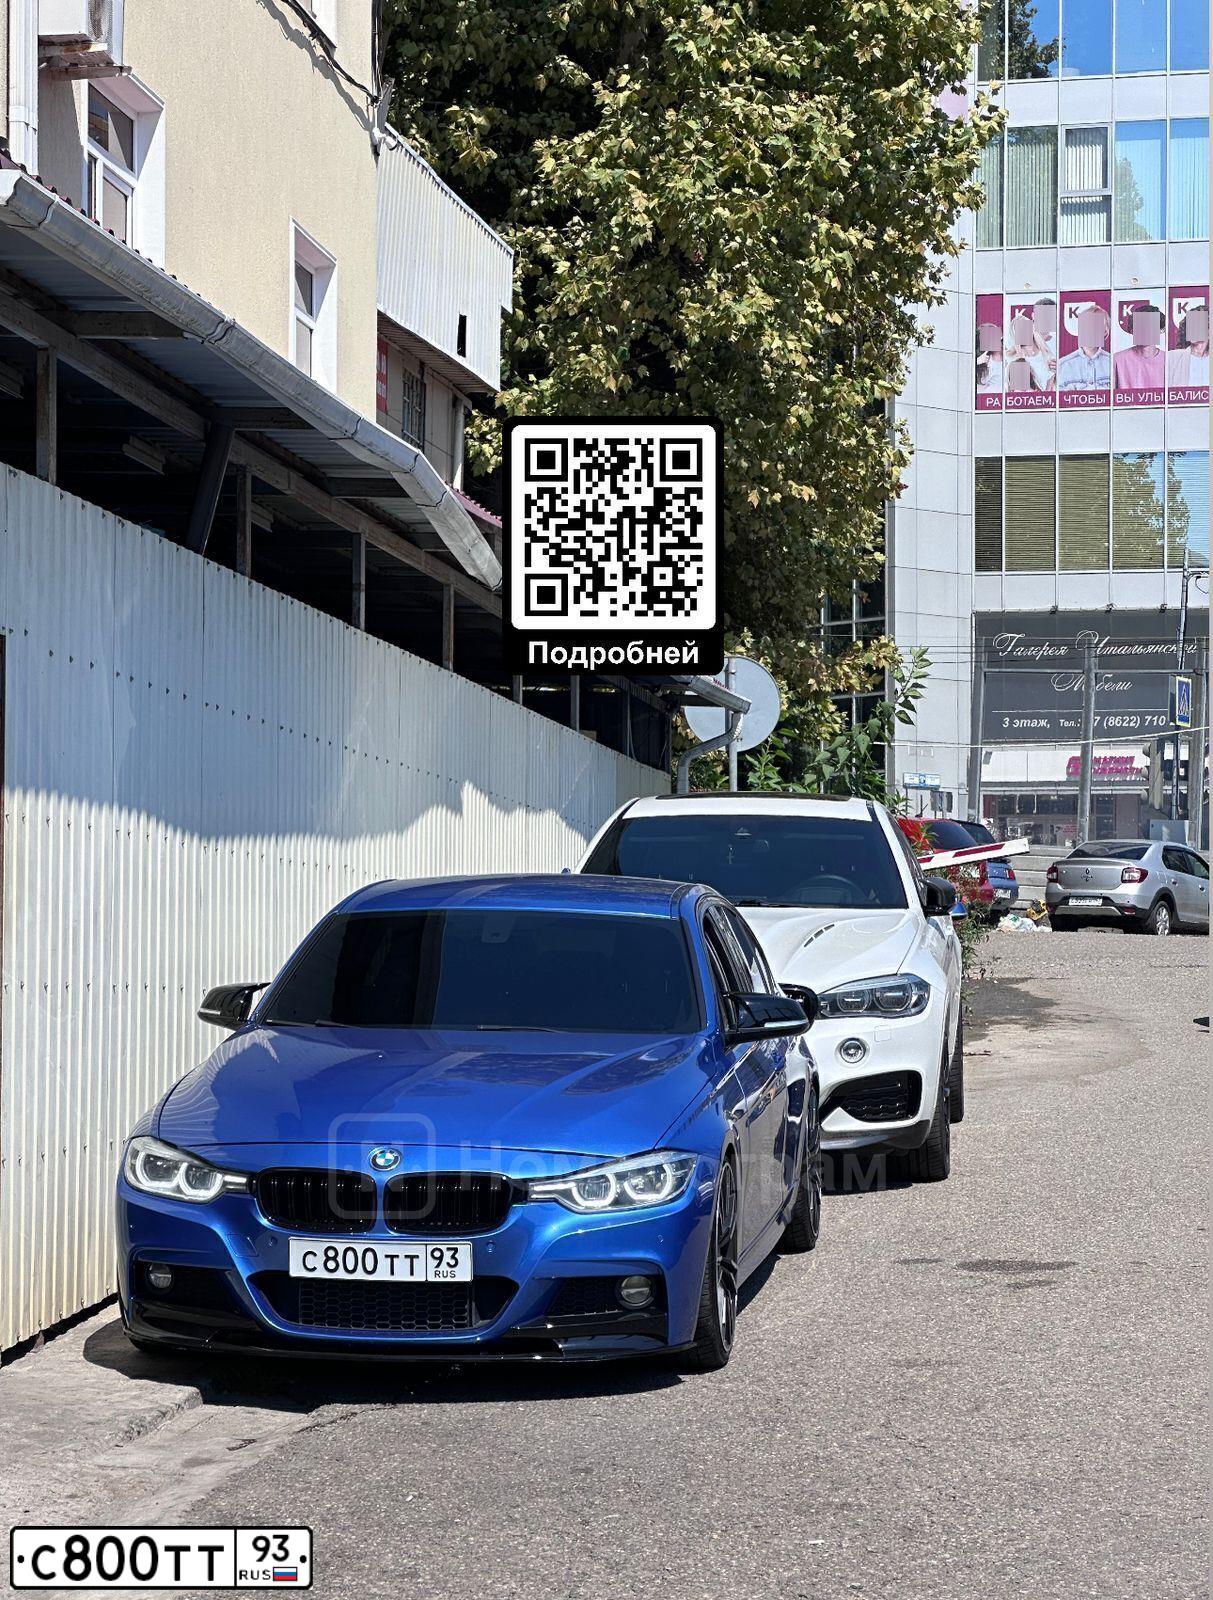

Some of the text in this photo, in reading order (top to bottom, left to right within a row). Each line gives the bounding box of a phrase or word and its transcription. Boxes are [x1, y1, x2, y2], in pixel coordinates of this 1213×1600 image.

[986, 395, 1055, 407] РАБОТАЕМ,
[1063, 394, 1106, 404] ЧТОБЫ
[1116, 393, 1134, 403] ВЫ
[993, 633, 1069, 660] Галерея
[1051, 673, 1133, 692] Мбели
[1002, 717, 1010, 728] 3
[1012, 718, 1050, 729] этаж,
[1103, 716, 1141, 729] (8622)
[1144, 715, 1166, 726] 710
[430, 1247, 459, 1268] 93
[434, 1270, 456, 1278] RUS
